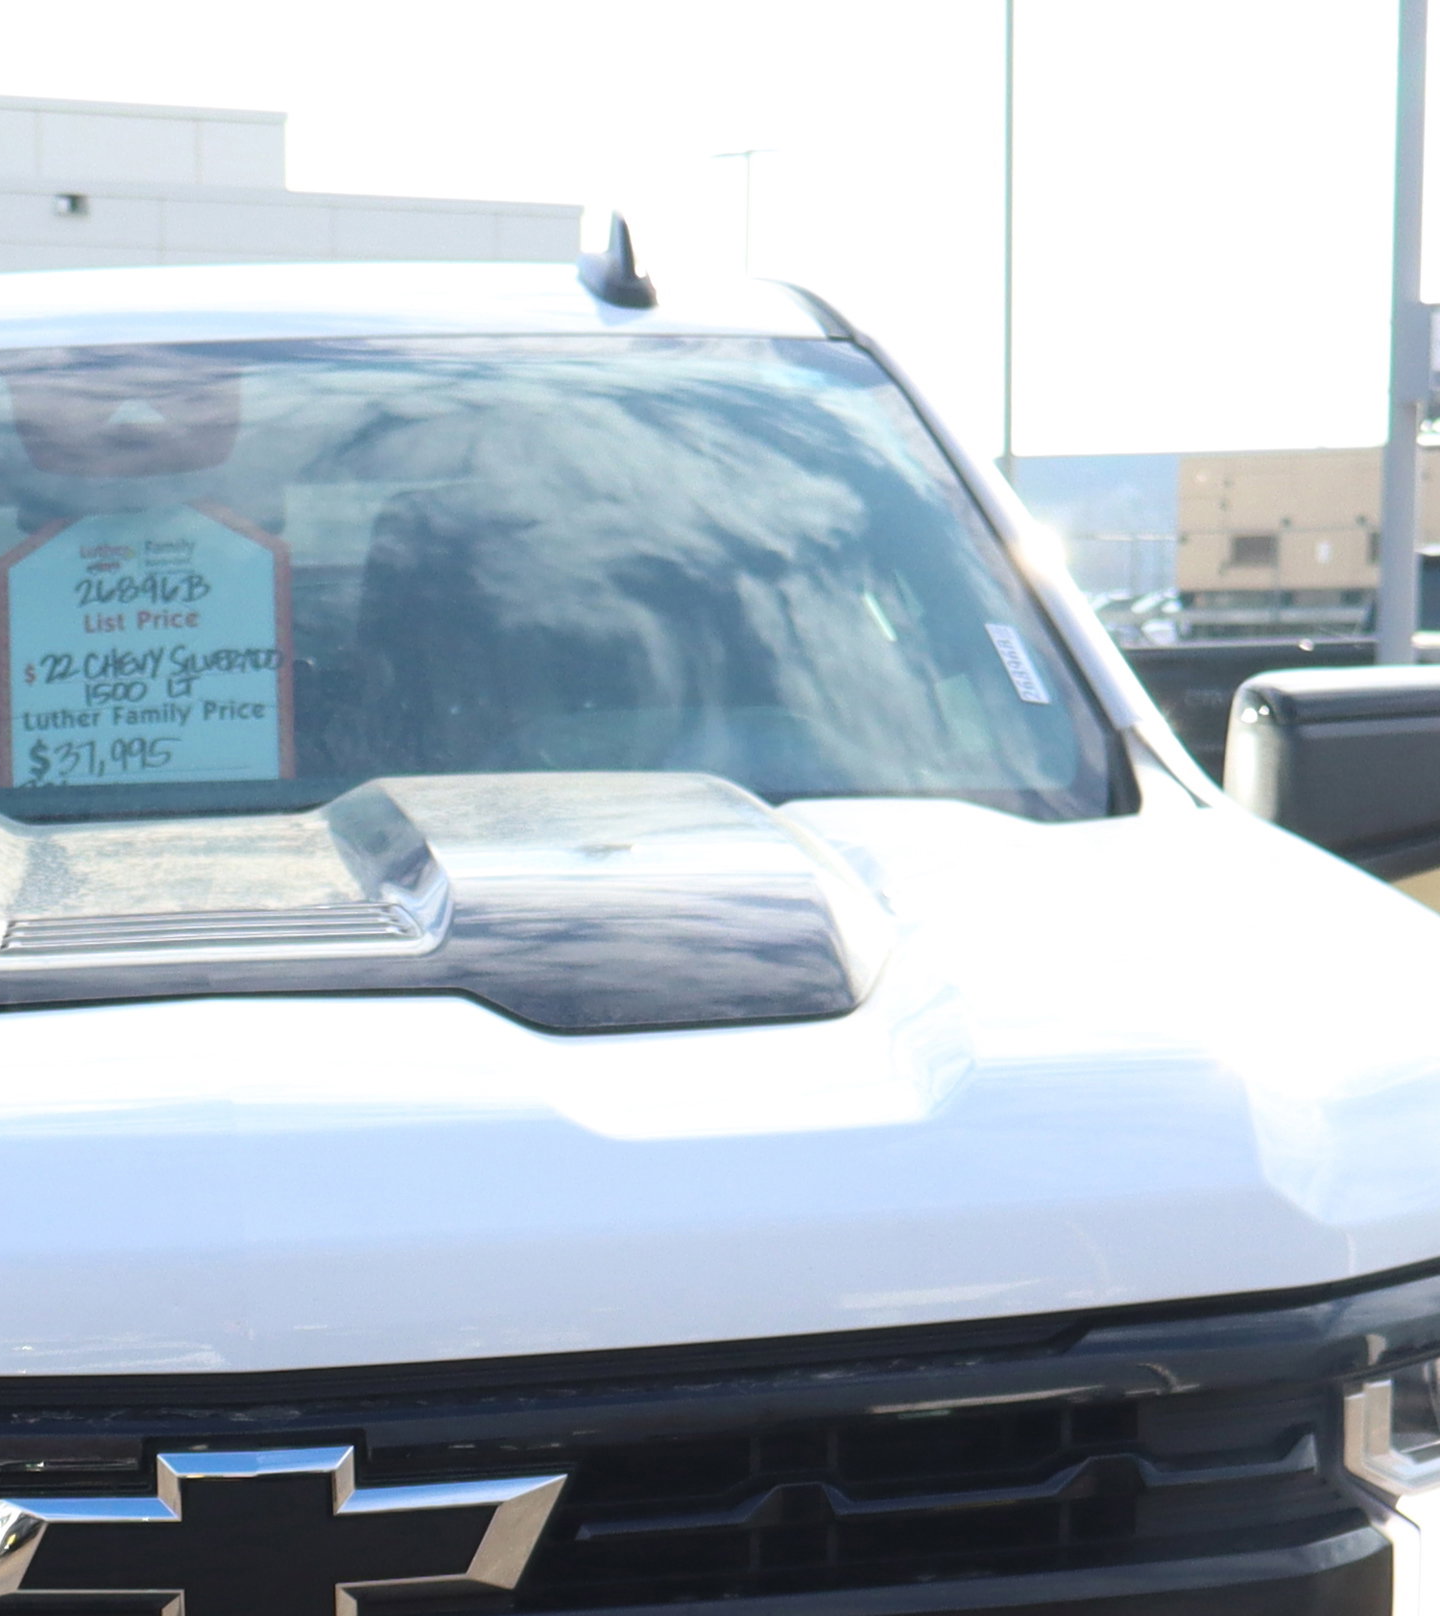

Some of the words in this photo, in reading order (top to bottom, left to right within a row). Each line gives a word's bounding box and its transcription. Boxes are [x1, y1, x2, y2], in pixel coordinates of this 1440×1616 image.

[74, 574, 212, 607] 26896B
[84, 613, 125, 633] List
[136, 611, 200, 630] Price
[84, 646, 165, 680] CHEVY
[84, 681, 148, 706] 1500
[166, 675, 201, 698] LT
[23, 710, 100, 731] Luther
[112, 703, 192, 727] Family
[203, 700, 267, 720] Price
